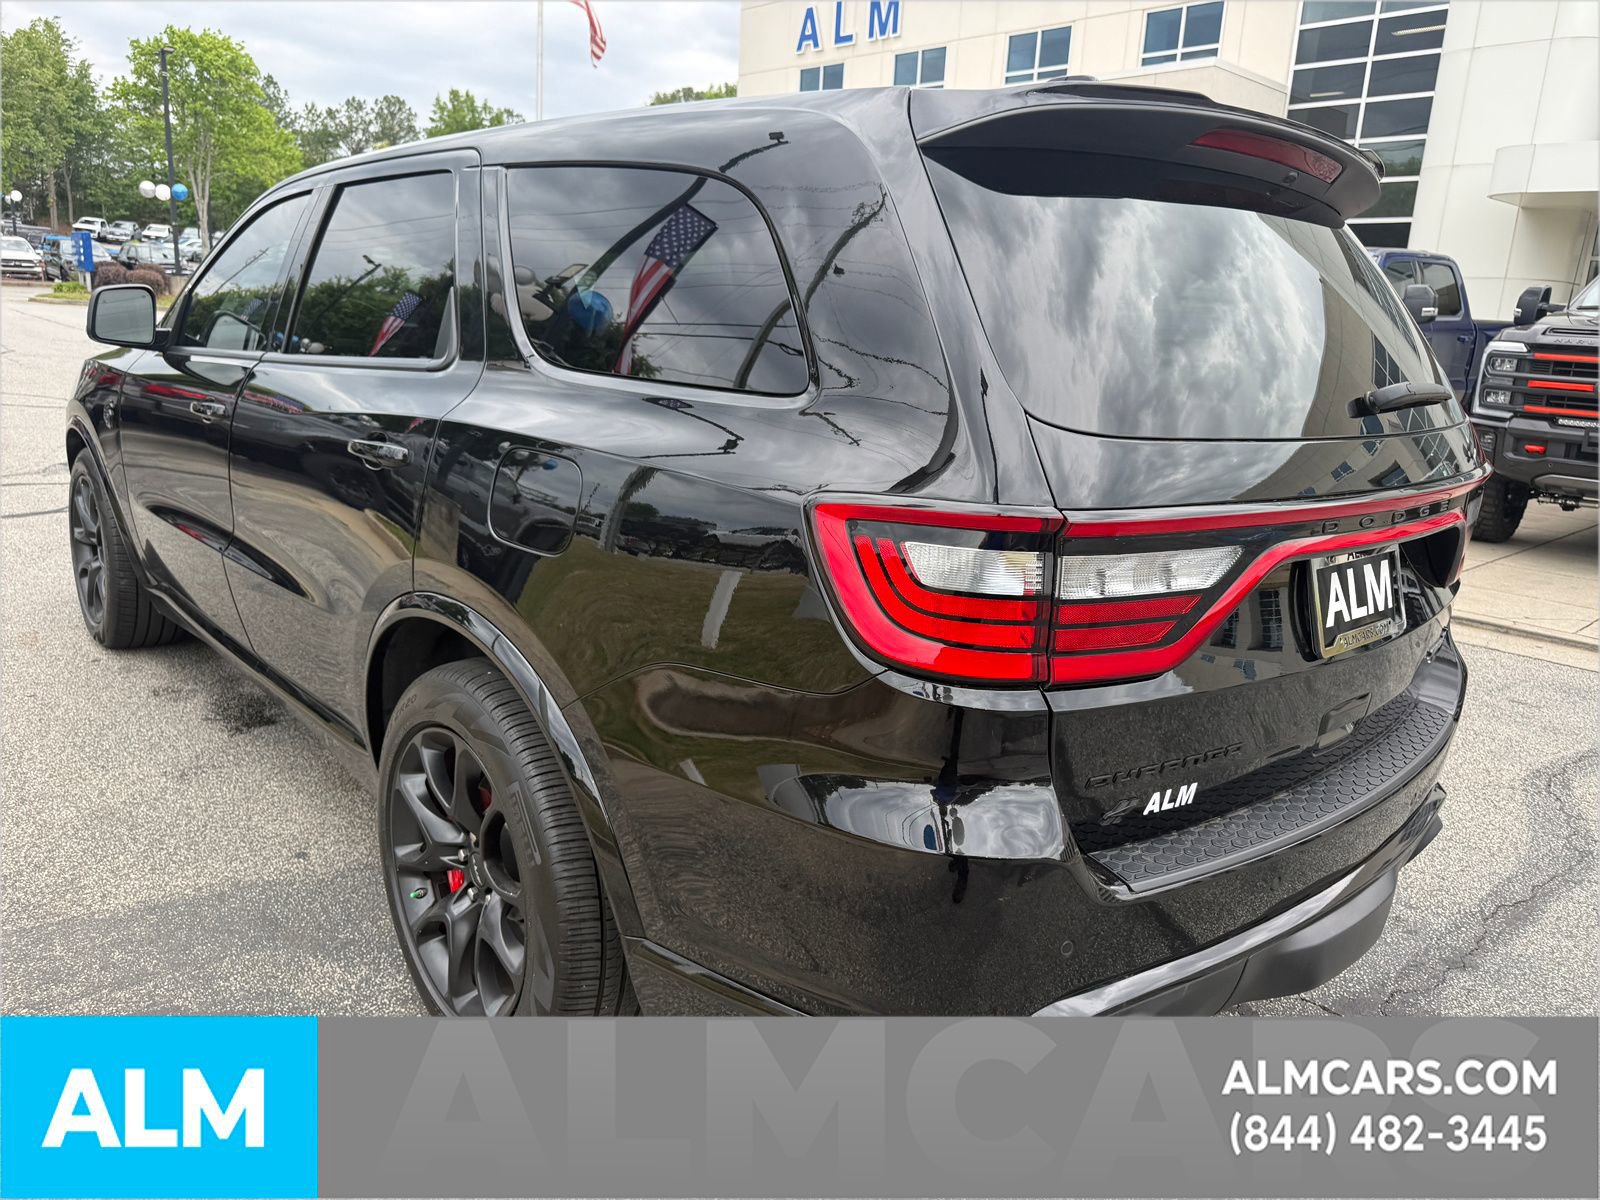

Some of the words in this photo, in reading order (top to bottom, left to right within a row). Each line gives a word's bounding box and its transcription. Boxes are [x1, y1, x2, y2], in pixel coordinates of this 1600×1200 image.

[797, 0, 899, 52] ALM
[1320, 500, 1450, 534] DODGE
[1326, 559, 1393, 629] ALM
